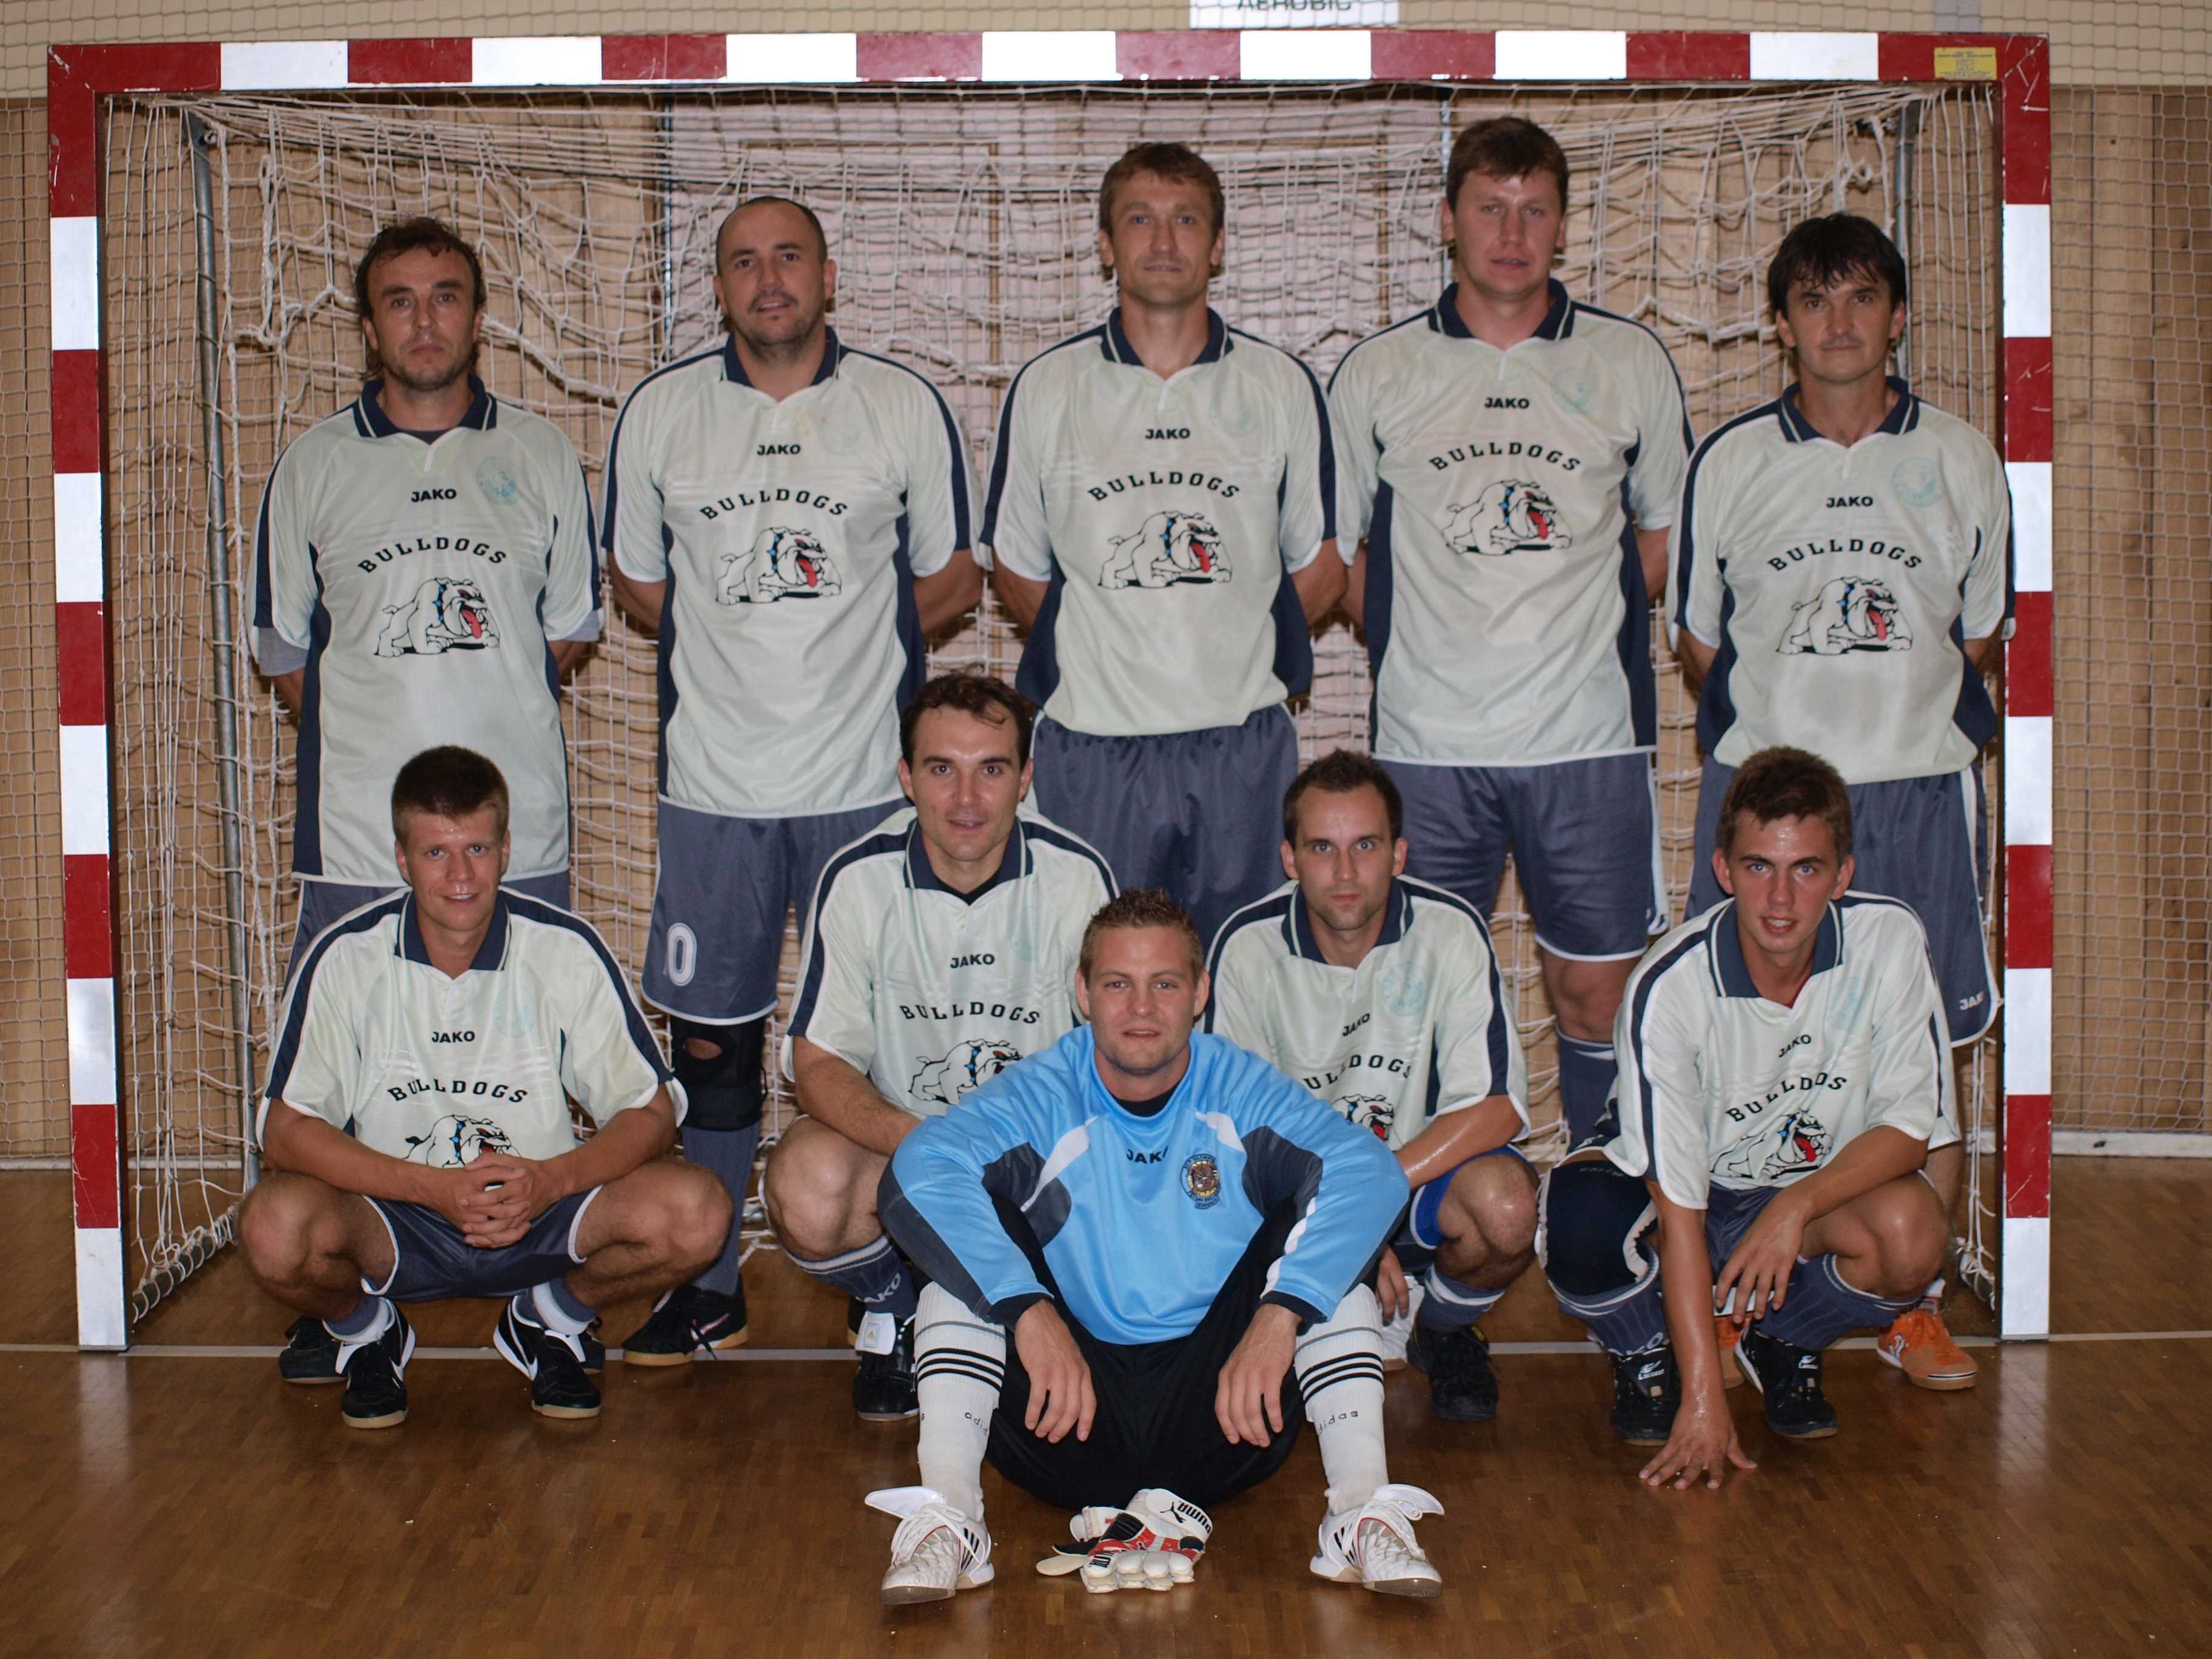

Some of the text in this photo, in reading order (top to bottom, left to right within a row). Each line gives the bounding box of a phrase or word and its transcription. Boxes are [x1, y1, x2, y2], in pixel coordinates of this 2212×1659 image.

[1484, 397, 1530, 409] JAKO
[1145, 428, 1190, 440] JAKO
[757, 444, 801, 456] JAKO
[1429, 442, 1580, 471] BULLDOGS
[1088, 472, 1239, 501] BULLDOGS
[411, 489, 457, 503] JAKO
[700, 489, 848, 520] BULLDOGS
[1826, 496, 1873, 508] JAKO
[357, 537, 506, 573] BULLDOGS
[1768, 539, 1922, 571] BULLDOGS
[950, 954, 995, 969] JAKO
[900, 1002, 1040, 1024] BULLDOGS
[431, 1031, 475, 1043] JAKO
[387, 1078, 528, 1103] BULLDOGS
